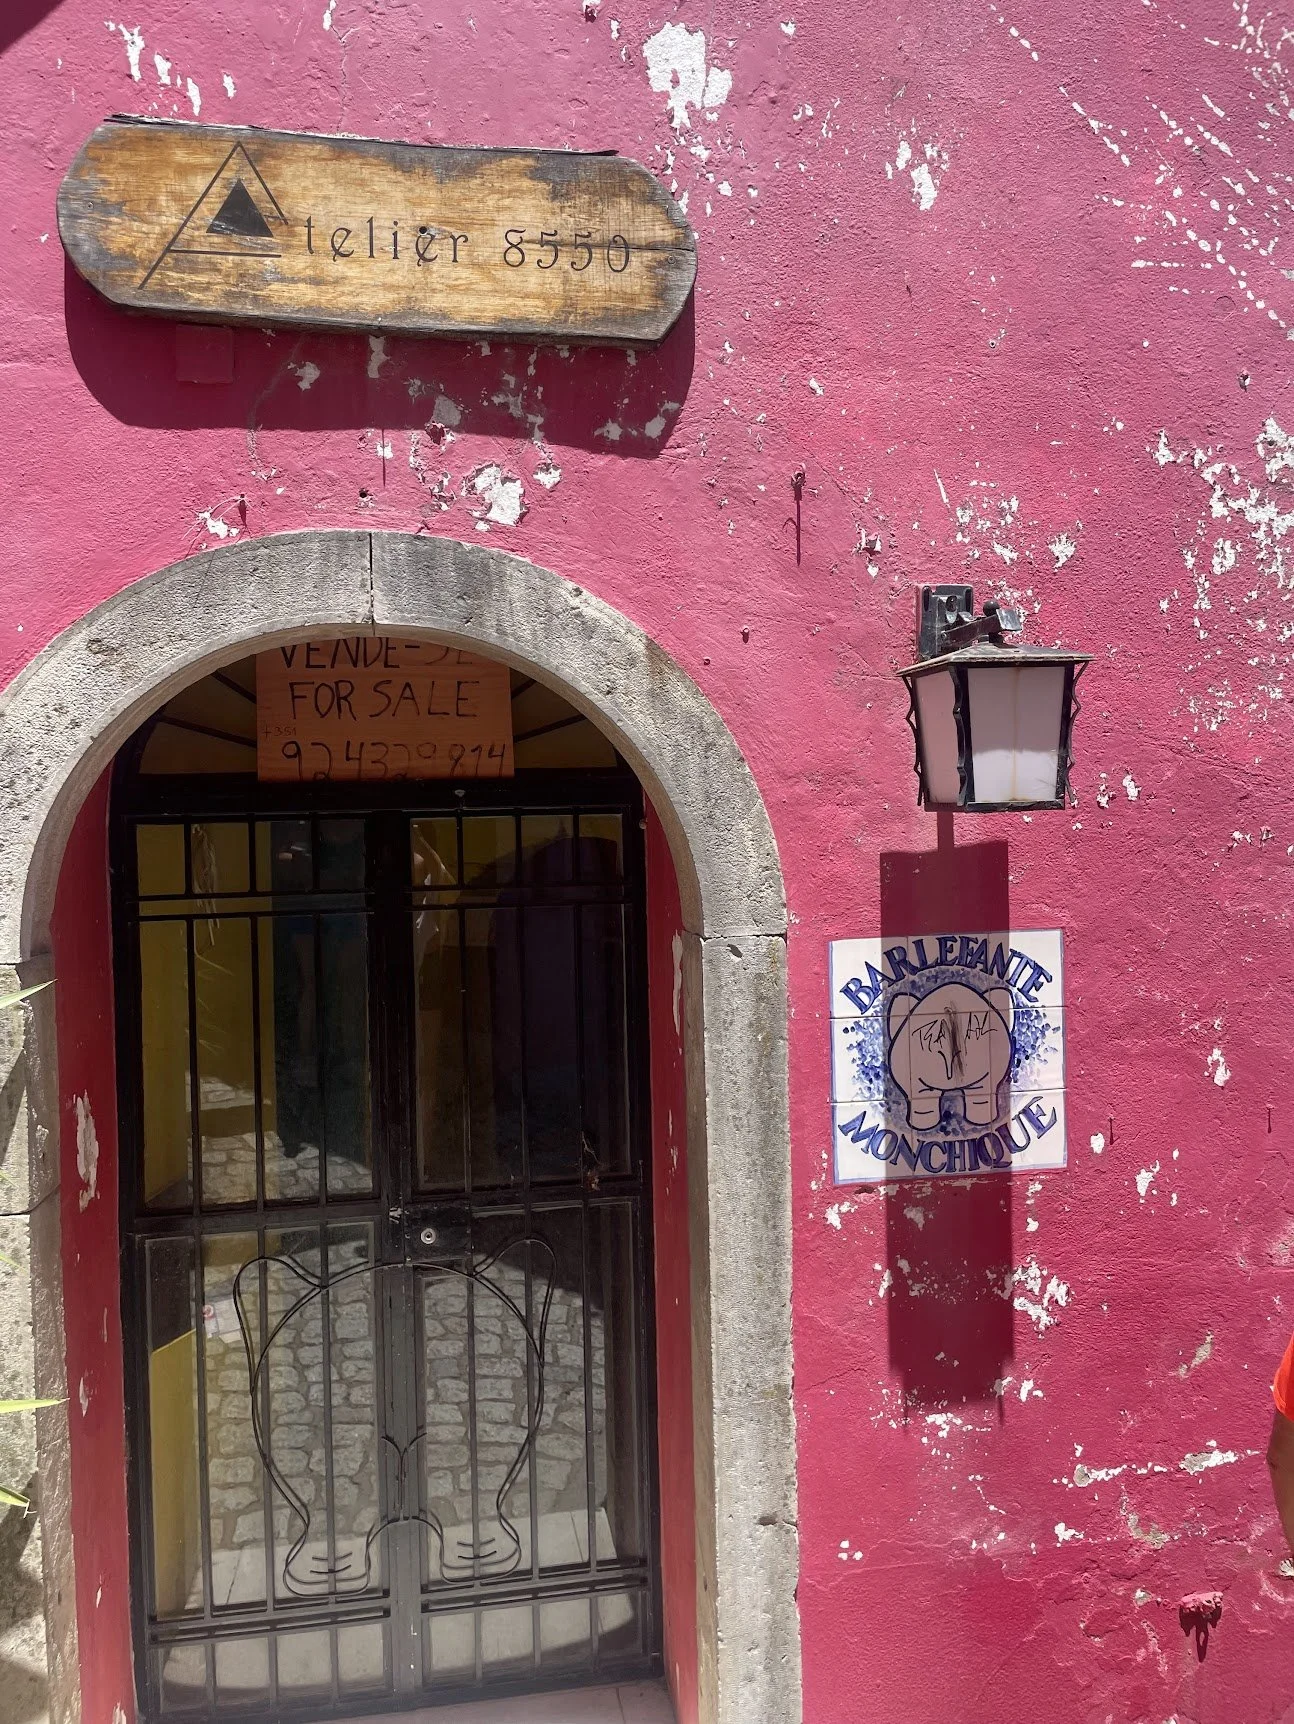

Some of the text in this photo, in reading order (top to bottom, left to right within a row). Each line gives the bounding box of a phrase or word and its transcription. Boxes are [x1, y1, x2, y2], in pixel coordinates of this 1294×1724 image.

[501, 227, 631, 274] 8550
[288, 679, 480, 721] FOR SALE
[839, 935, 1053, 1016] BARLEFANTE
[838, 1095, 1058, 1174] MONCHIQUE
